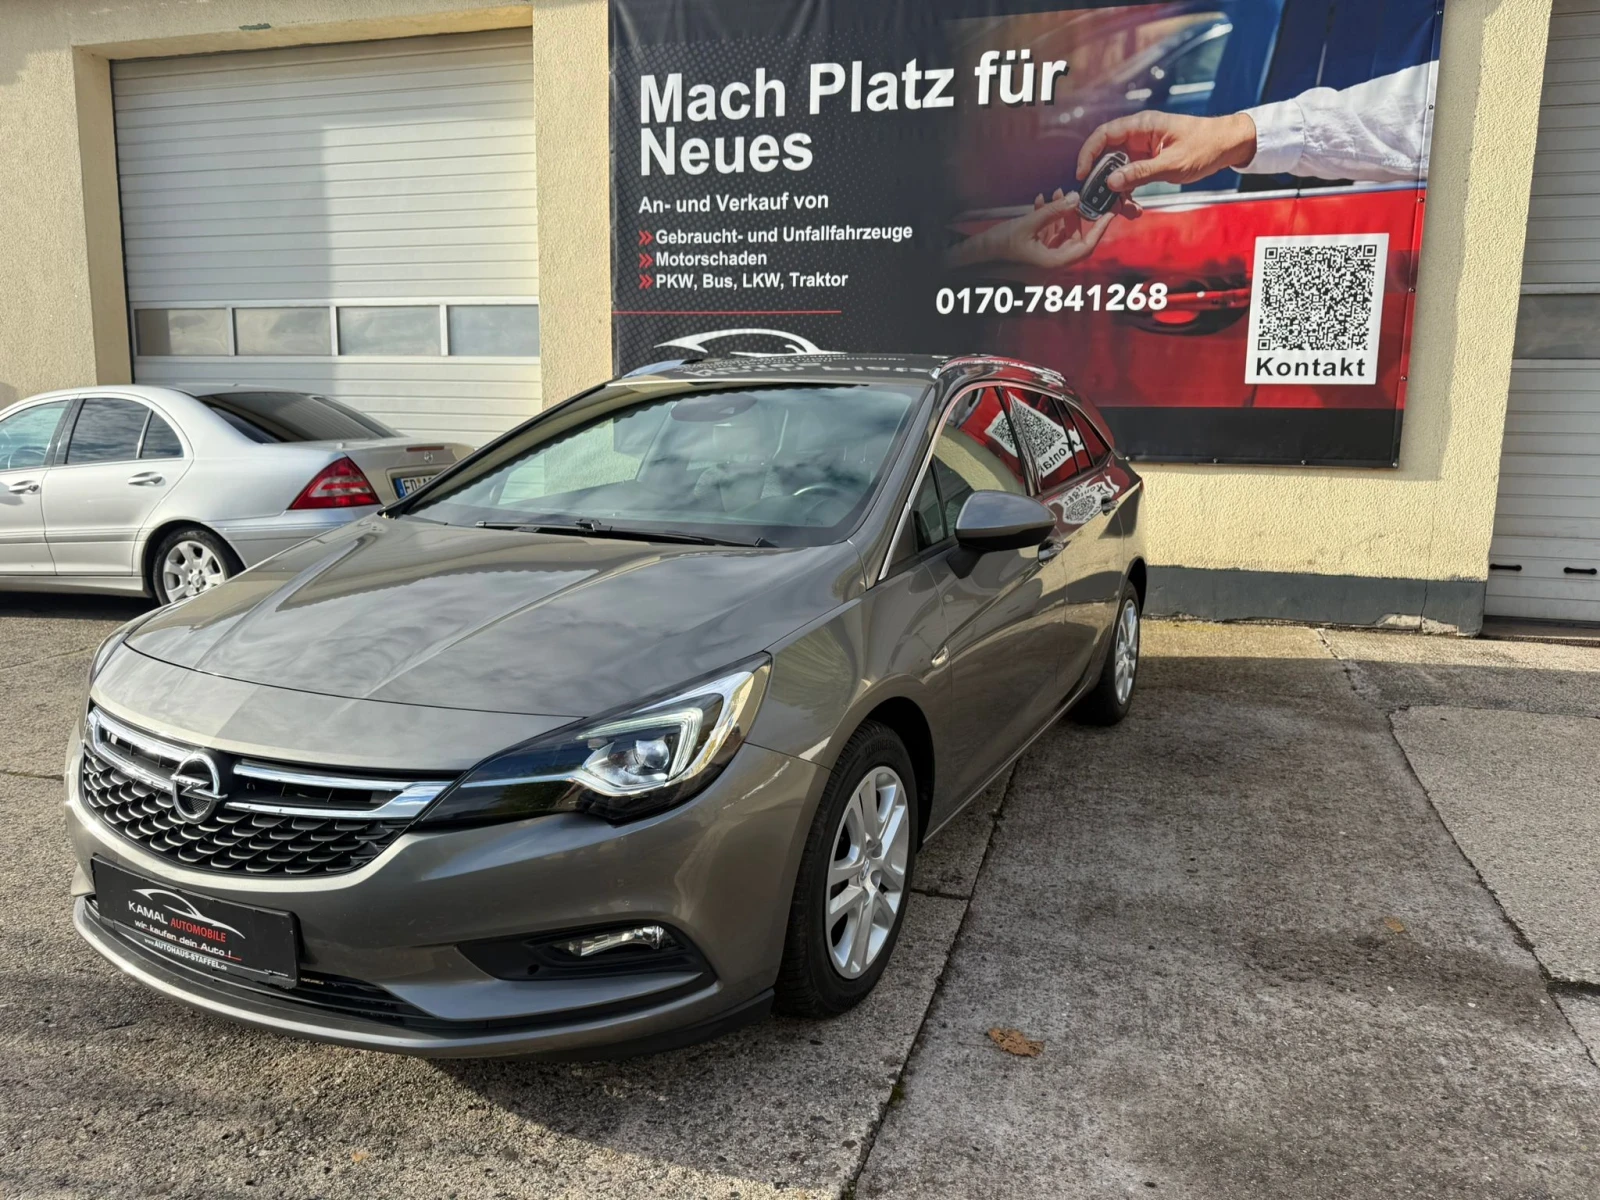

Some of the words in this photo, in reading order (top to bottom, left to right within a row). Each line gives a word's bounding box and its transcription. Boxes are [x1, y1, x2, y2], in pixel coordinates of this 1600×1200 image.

[640, 67, 786, 124] Mach
[809, 58, 955, 115] Platz
[974, 48, 1067, 106] für
[640, 126, 813, 176] Neues
[638, 196, 671, 214] An-
[676, 195, 711, 213] und
[716, 192, 789, 212] Verkauf
[793, 194, 829, 209] von
[655, 229, 744, 245] Gebraucht-
[747, 227, 778, 243] und
[782, 224, 913, 243] Unfallfahrzeuge
[655, 250, 768, 267] Motorschaden
[655, 273, 698, 291] PKW,
[702, 273, 738, 291] Bus,
[742, 272, 785, 290] LKW,
[789, 271, 849, 287] Traktor
[935, 282, 1168, 315] 0170-7841268
[1256, 356, 1366, 378] Kontakt
[128, 901, 168, 925] KAMAL
[170, 918, 226, 943] AUTOMOBILE
[134, 920, 148, 930] wir
[149, 924, 177, 942] kaufen
[179, 936, 198, 949] dein
[200, 942, 225, 957] Auto
